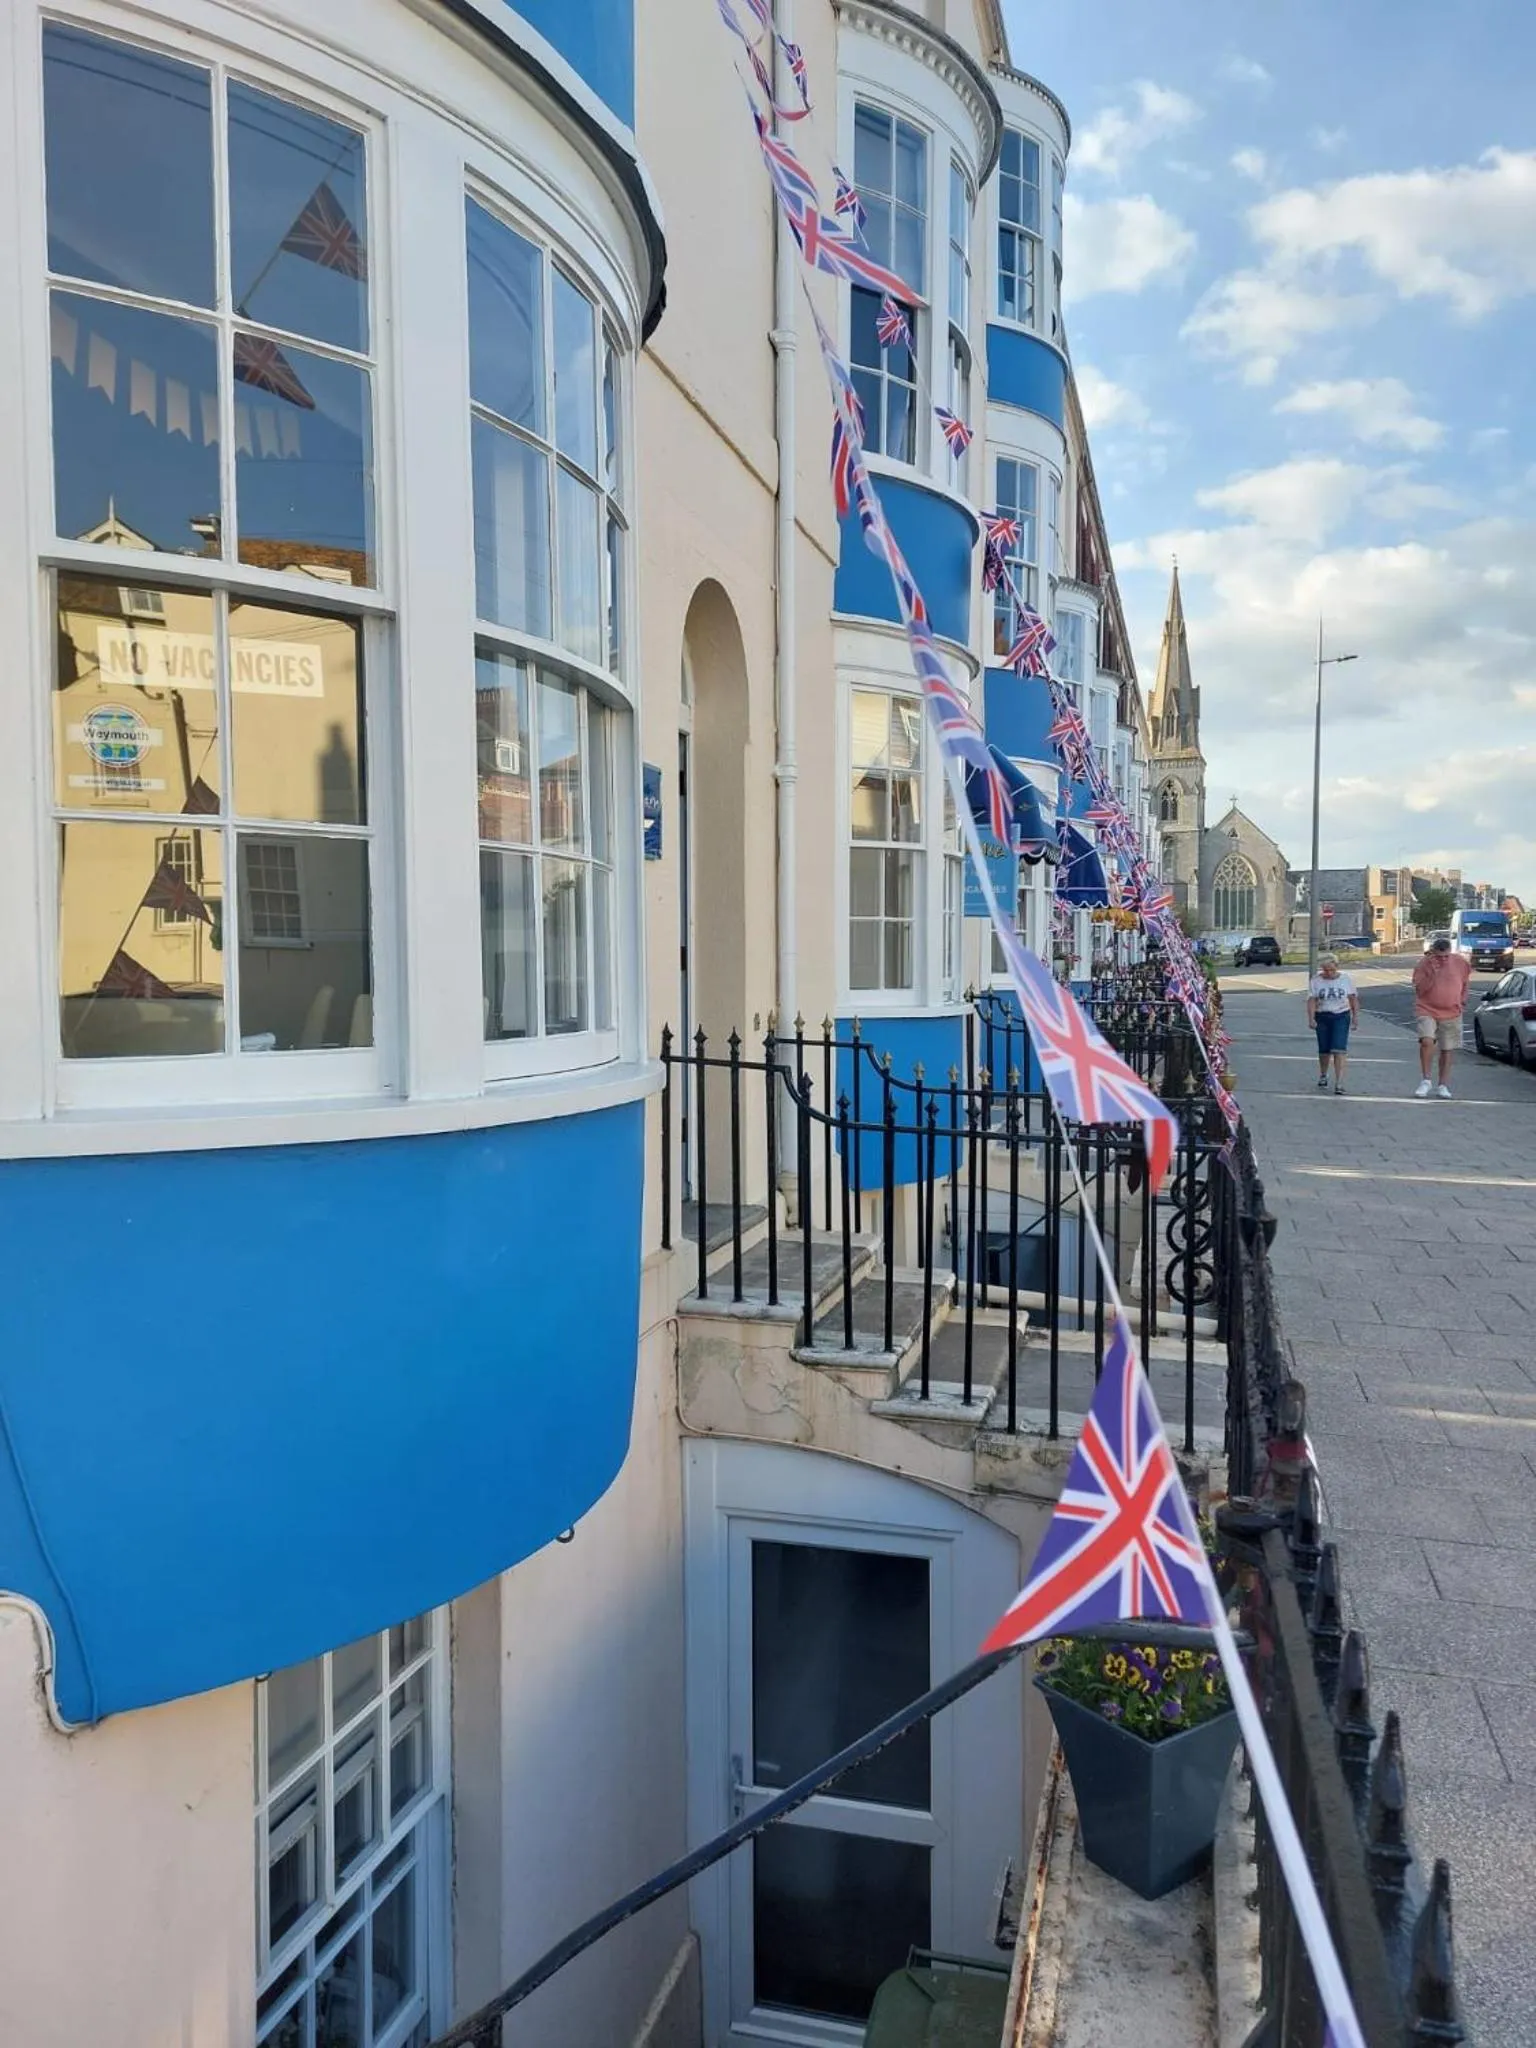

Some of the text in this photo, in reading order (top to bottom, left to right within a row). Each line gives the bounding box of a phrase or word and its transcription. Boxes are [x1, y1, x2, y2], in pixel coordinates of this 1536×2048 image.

[109, 640, 315, 687] NO VACNCIES
[83, 727, 149, 741] Weymouth
[1318, 987, 1346, 1000] GAP
